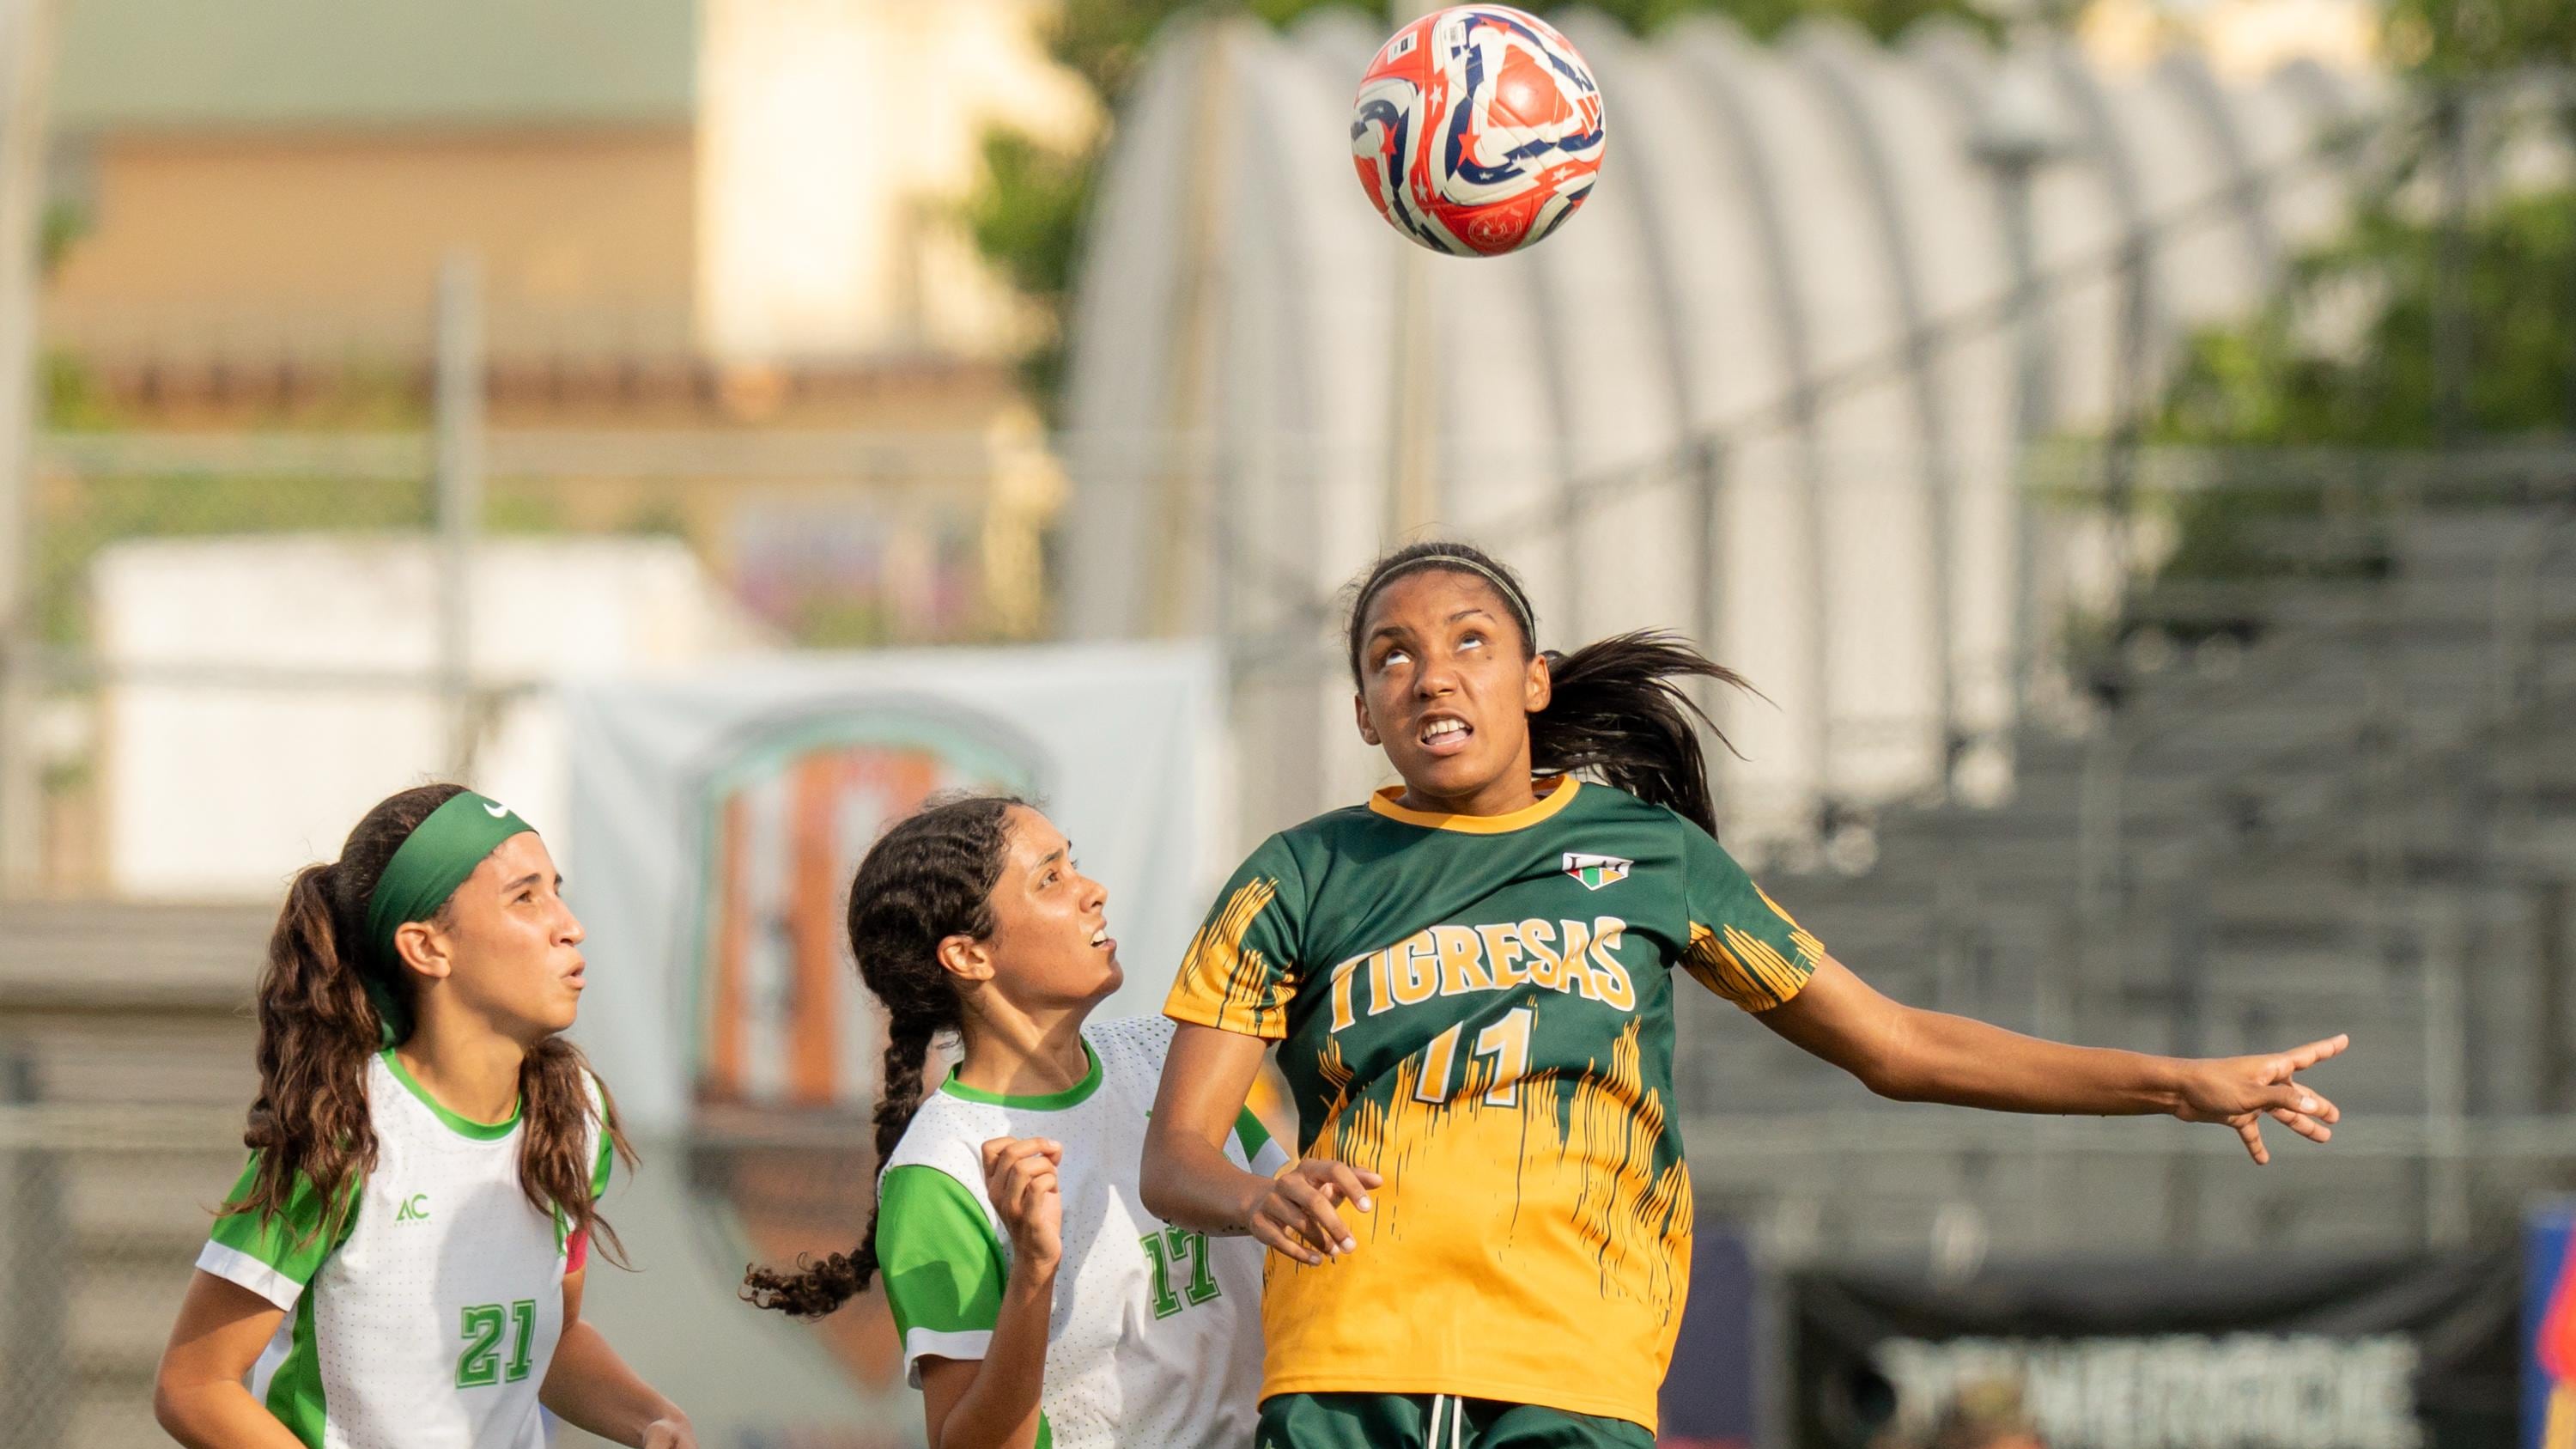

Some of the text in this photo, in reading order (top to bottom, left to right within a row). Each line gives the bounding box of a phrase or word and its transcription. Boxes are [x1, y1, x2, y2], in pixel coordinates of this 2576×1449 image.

[1330, 916, 1636, 1033] TIGRESAS
[1414, 1008, 1533, 1106] 11
[396, 1194, 429, 1221] AC
[1139, 1225, 1222, 1320] 17
[455, 1300, 537, 1389] 21
